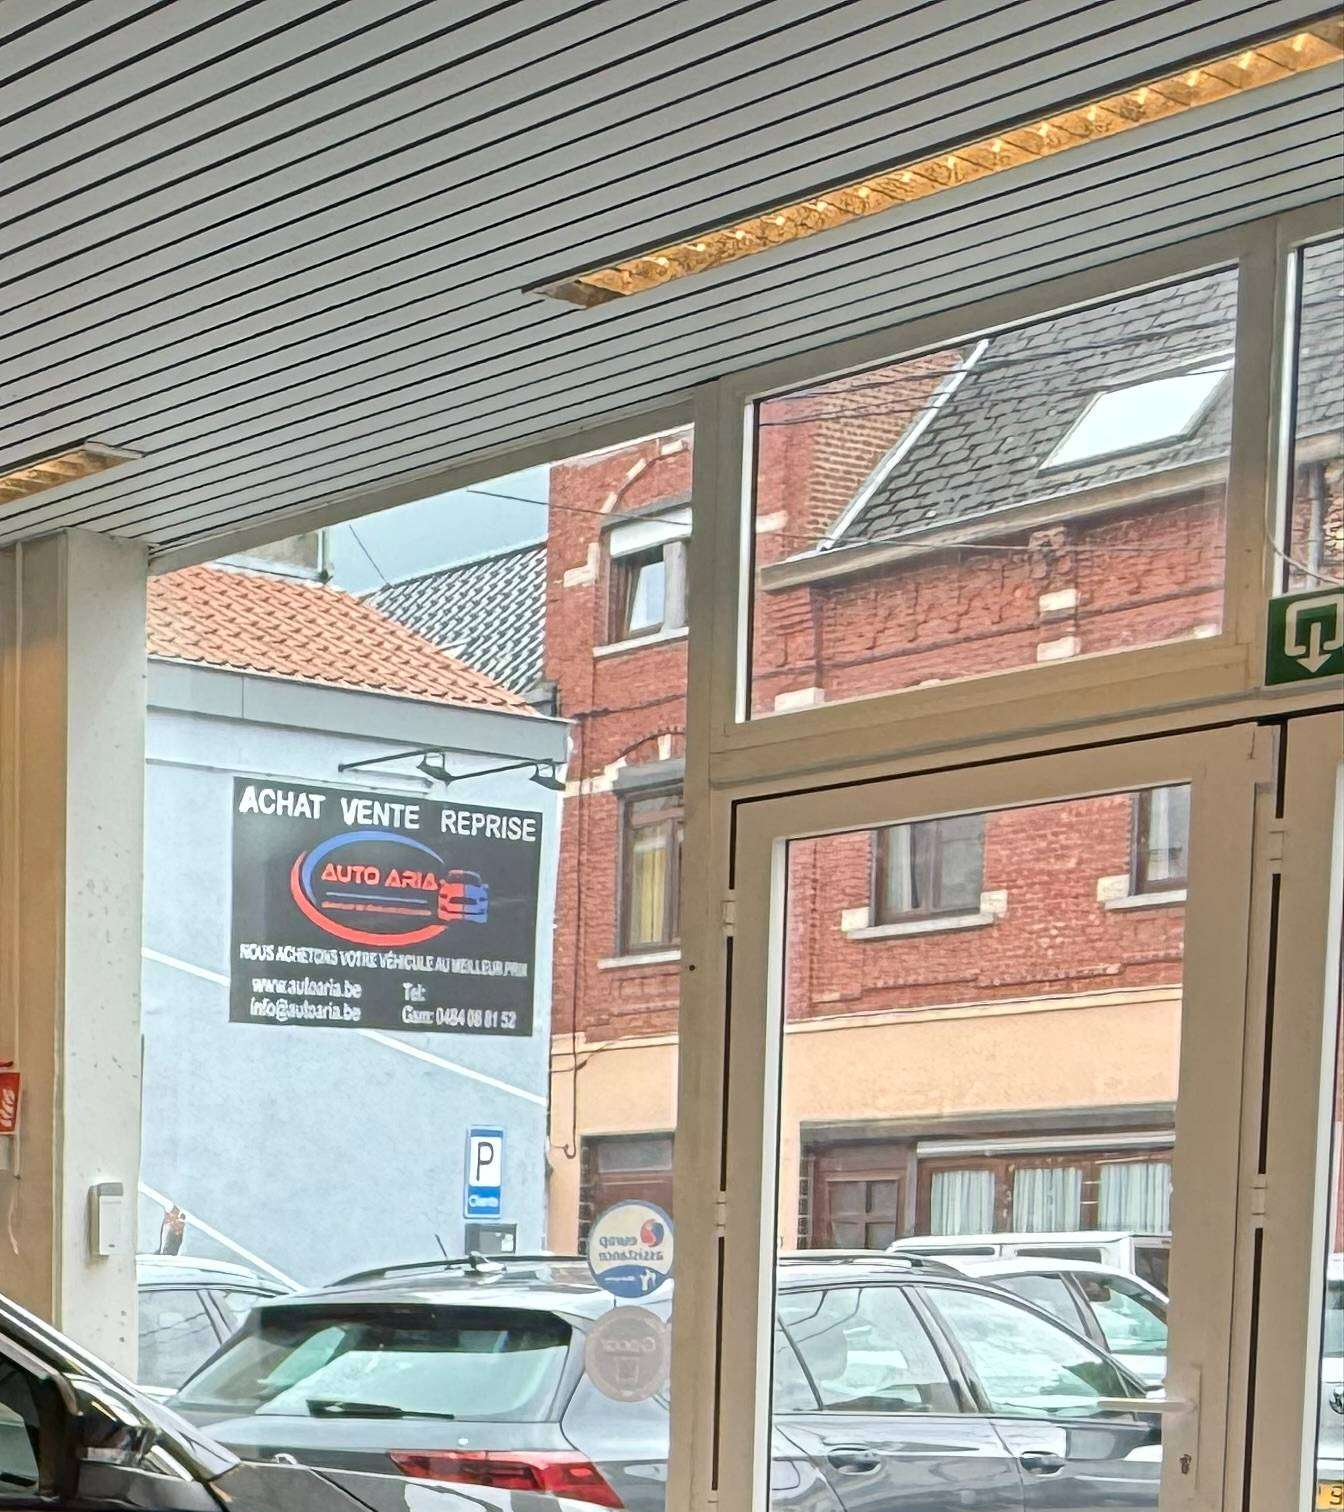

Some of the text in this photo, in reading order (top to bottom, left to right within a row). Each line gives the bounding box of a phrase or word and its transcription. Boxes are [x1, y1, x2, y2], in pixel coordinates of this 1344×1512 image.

[238, 785, 536, 841] ACHAT VENTE REPRISE
[321, 863, 438, 890] AUTO ARIA
[239, 943, 274, 961] NOUS
[275, 945, 338, 965] ACHETONS
[339, 949, 378, 968] VOTRE
[476, 1141, 494, 1182] P
